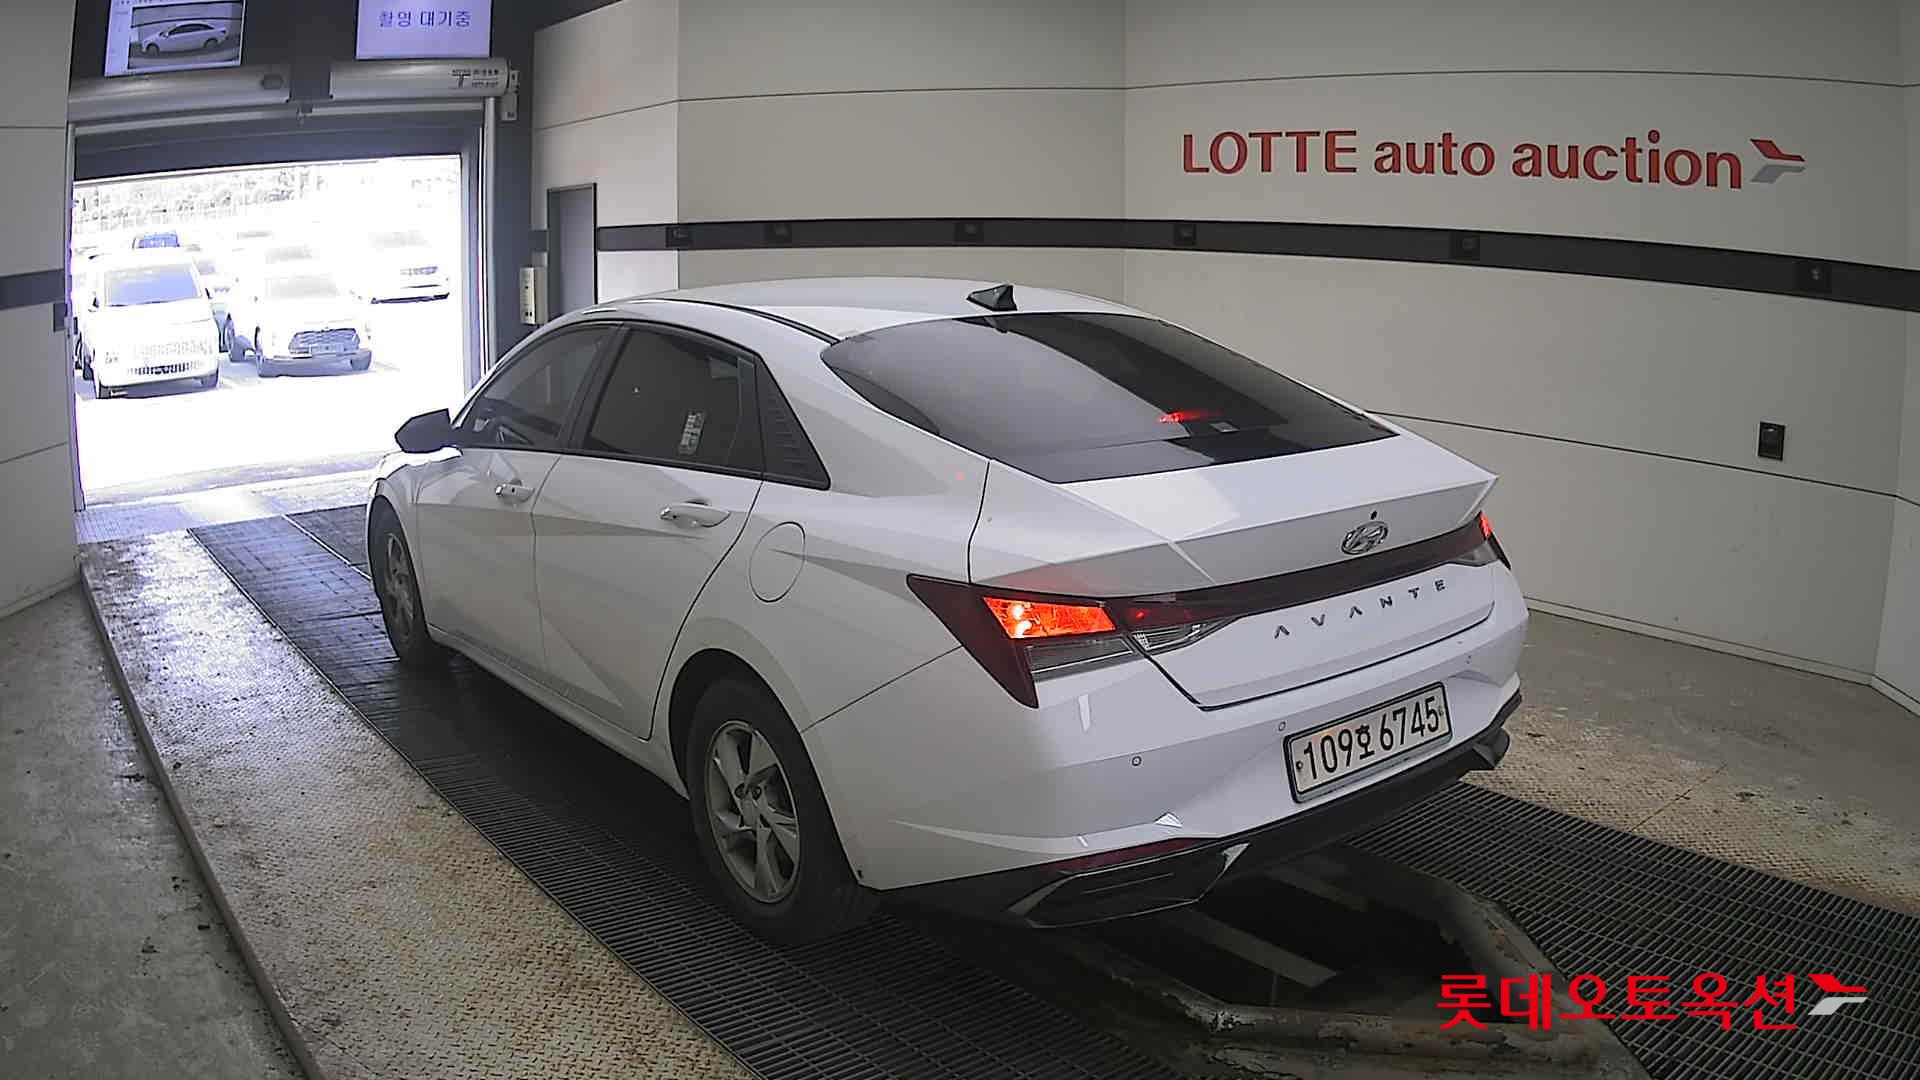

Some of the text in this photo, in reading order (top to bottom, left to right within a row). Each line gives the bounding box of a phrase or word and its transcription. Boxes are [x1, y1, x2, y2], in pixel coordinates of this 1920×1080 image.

[420, 10, 470, 28] 대기중
[1183, 129, 1742, 188] LOTTE auto auction
[1274, 578, 1446, 639] AVANTE
[1303, 695, 1439, 780] 109호 6745
